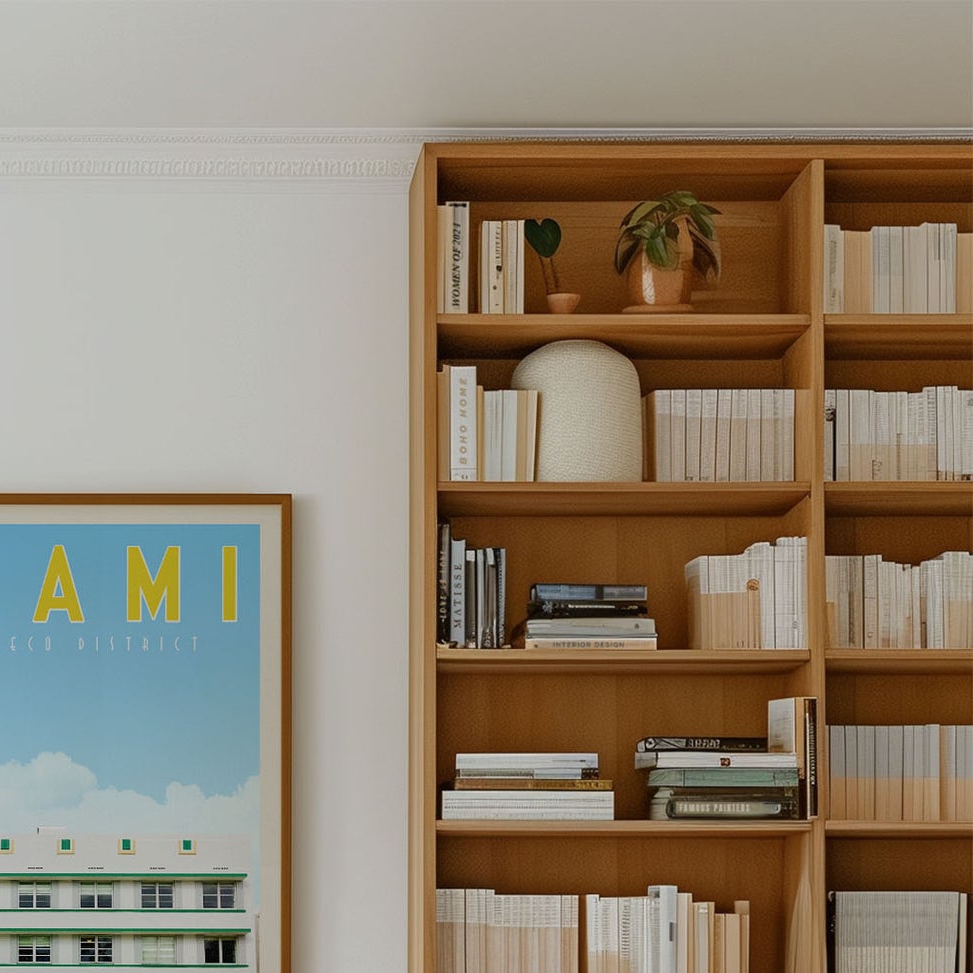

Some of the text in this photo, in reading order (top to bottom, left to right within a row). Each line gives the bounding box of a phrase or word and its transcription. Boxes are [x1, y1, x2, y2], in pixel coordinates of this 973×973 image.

[453, 247, 461, 261] OF
[452, 265, 460, 307] WOMEN
[459, 378, 467, 418] HOME
[459, 425, 467, 465] BOHO
[454, 564, 462, 629] MATISSE
[78, 636, 198, 651] DISTRICT
[678, 803, 750, 813] FAMOUS PAINTERS
